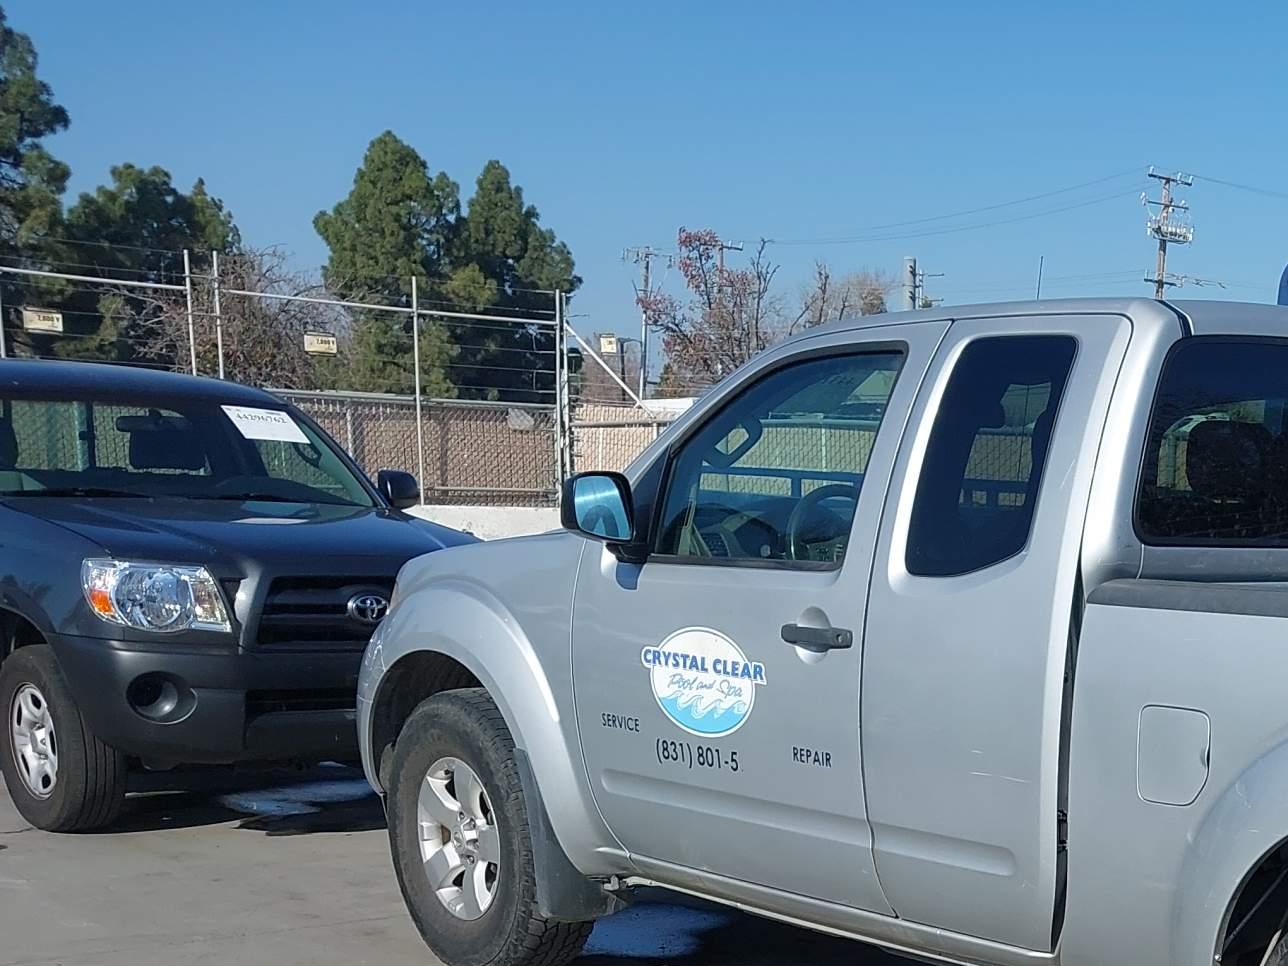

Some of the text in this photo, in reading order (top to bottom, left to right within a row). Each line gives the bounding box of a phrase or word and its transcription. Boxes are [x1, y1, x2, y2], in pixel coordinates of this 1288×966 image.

[643, 648, 764, 681] CRYSTAL CLEAR
[667, 673, 743, 699] Pool and Spa
[601, 712, 640, 733] SERVICE
[656, 738, 739, 772] (831) 801-5
[792, 746, 832, 768] REPAIR
